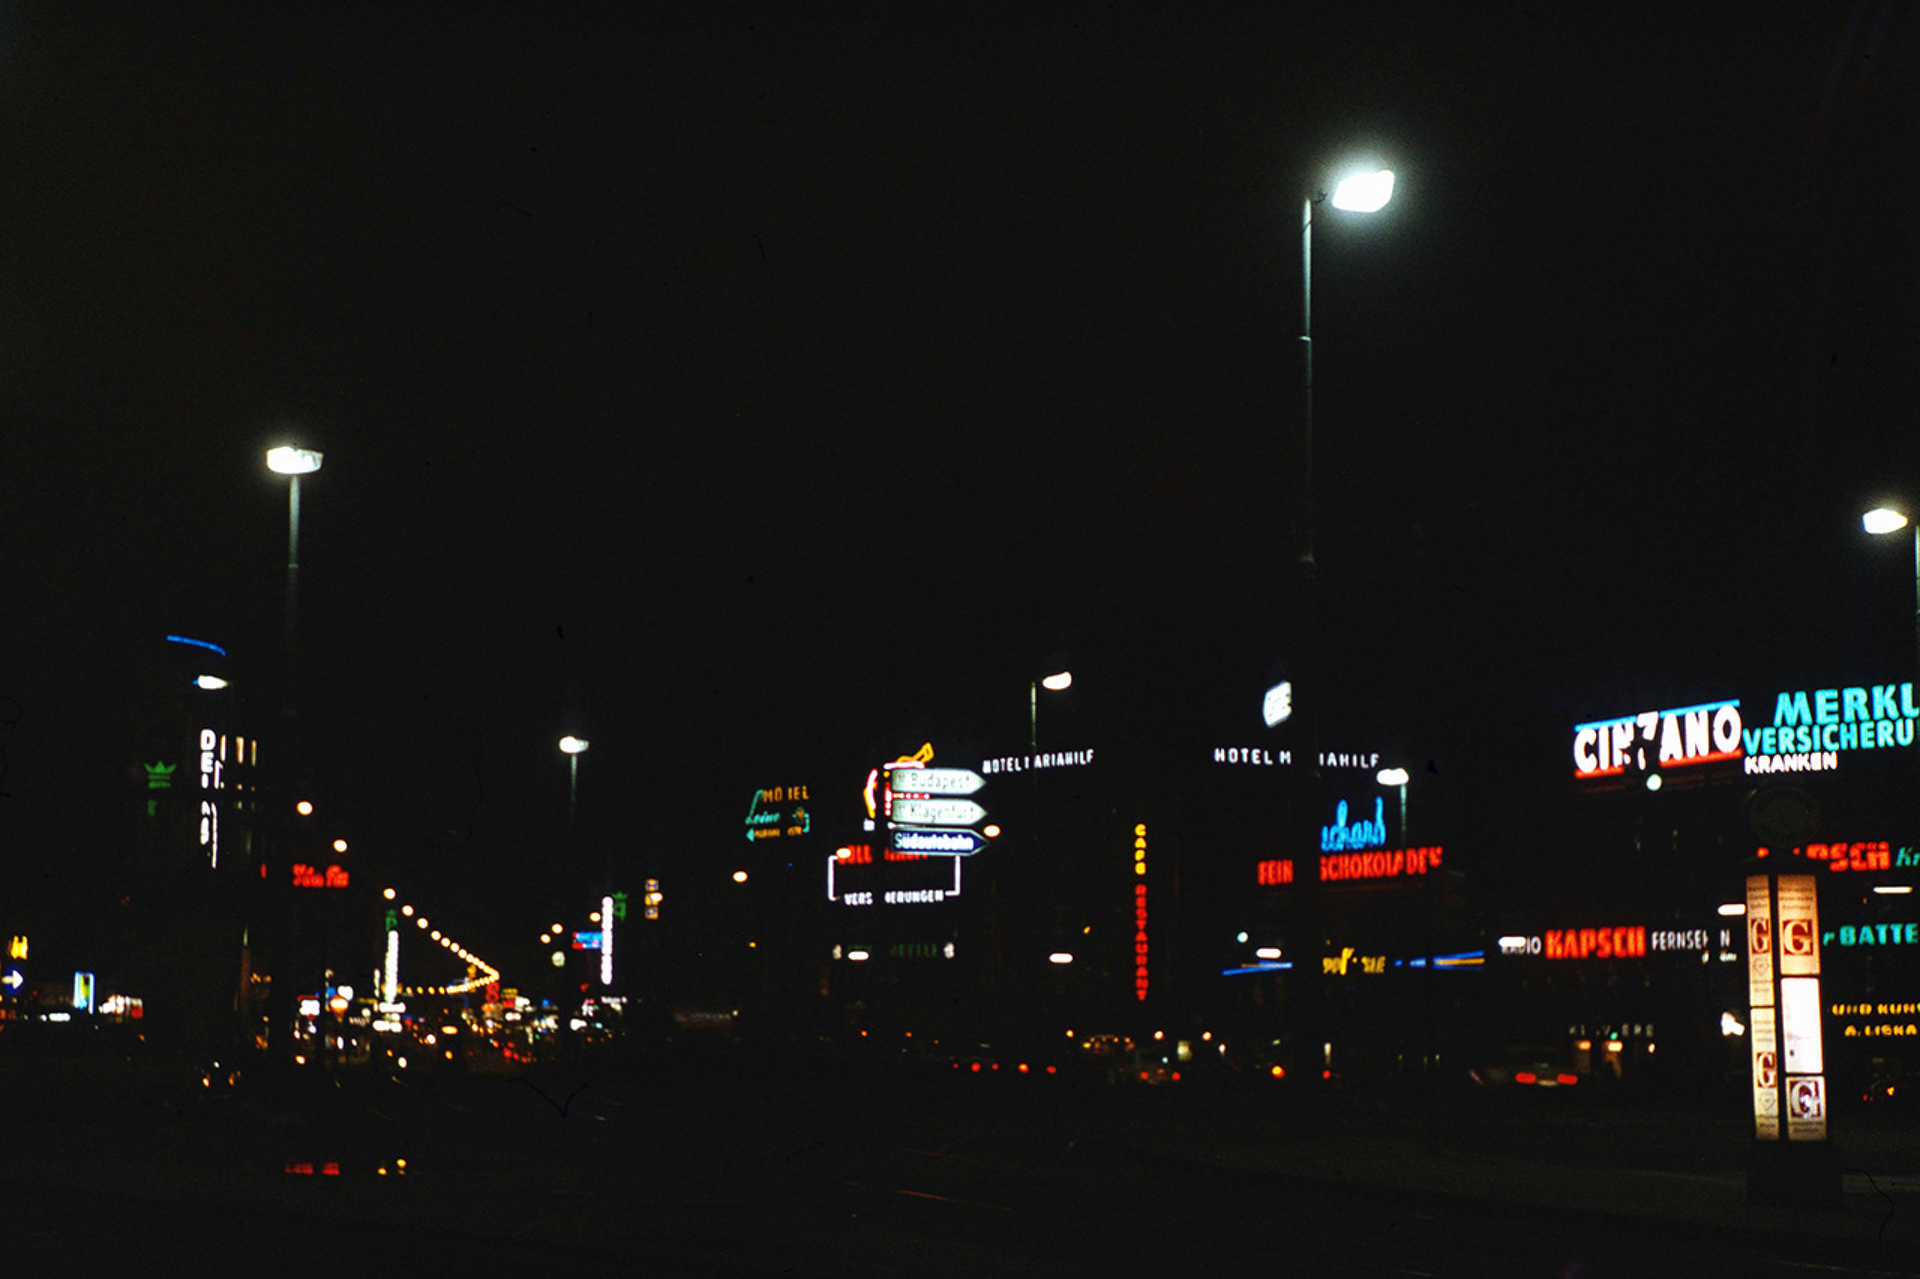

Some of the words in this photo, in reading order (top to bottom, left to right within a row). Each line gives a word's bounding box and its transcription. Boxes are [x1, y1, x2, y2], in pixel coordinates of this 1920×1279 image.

[1742, 718, 1920, 756] VERSICHERU
[982, 757, 1022, 774] HOTEL
[1024, 748, 1094, 769] ARIAHILF
[1214, 747, 1274, 765] HOTEL
[1744, 751, 1838, 774] KRANKEN
[1257, 859, 1294, 886] FEIN
[1545, 926, 1646, 959] KAPSCH
[1784, 920, 1813, 954] G
